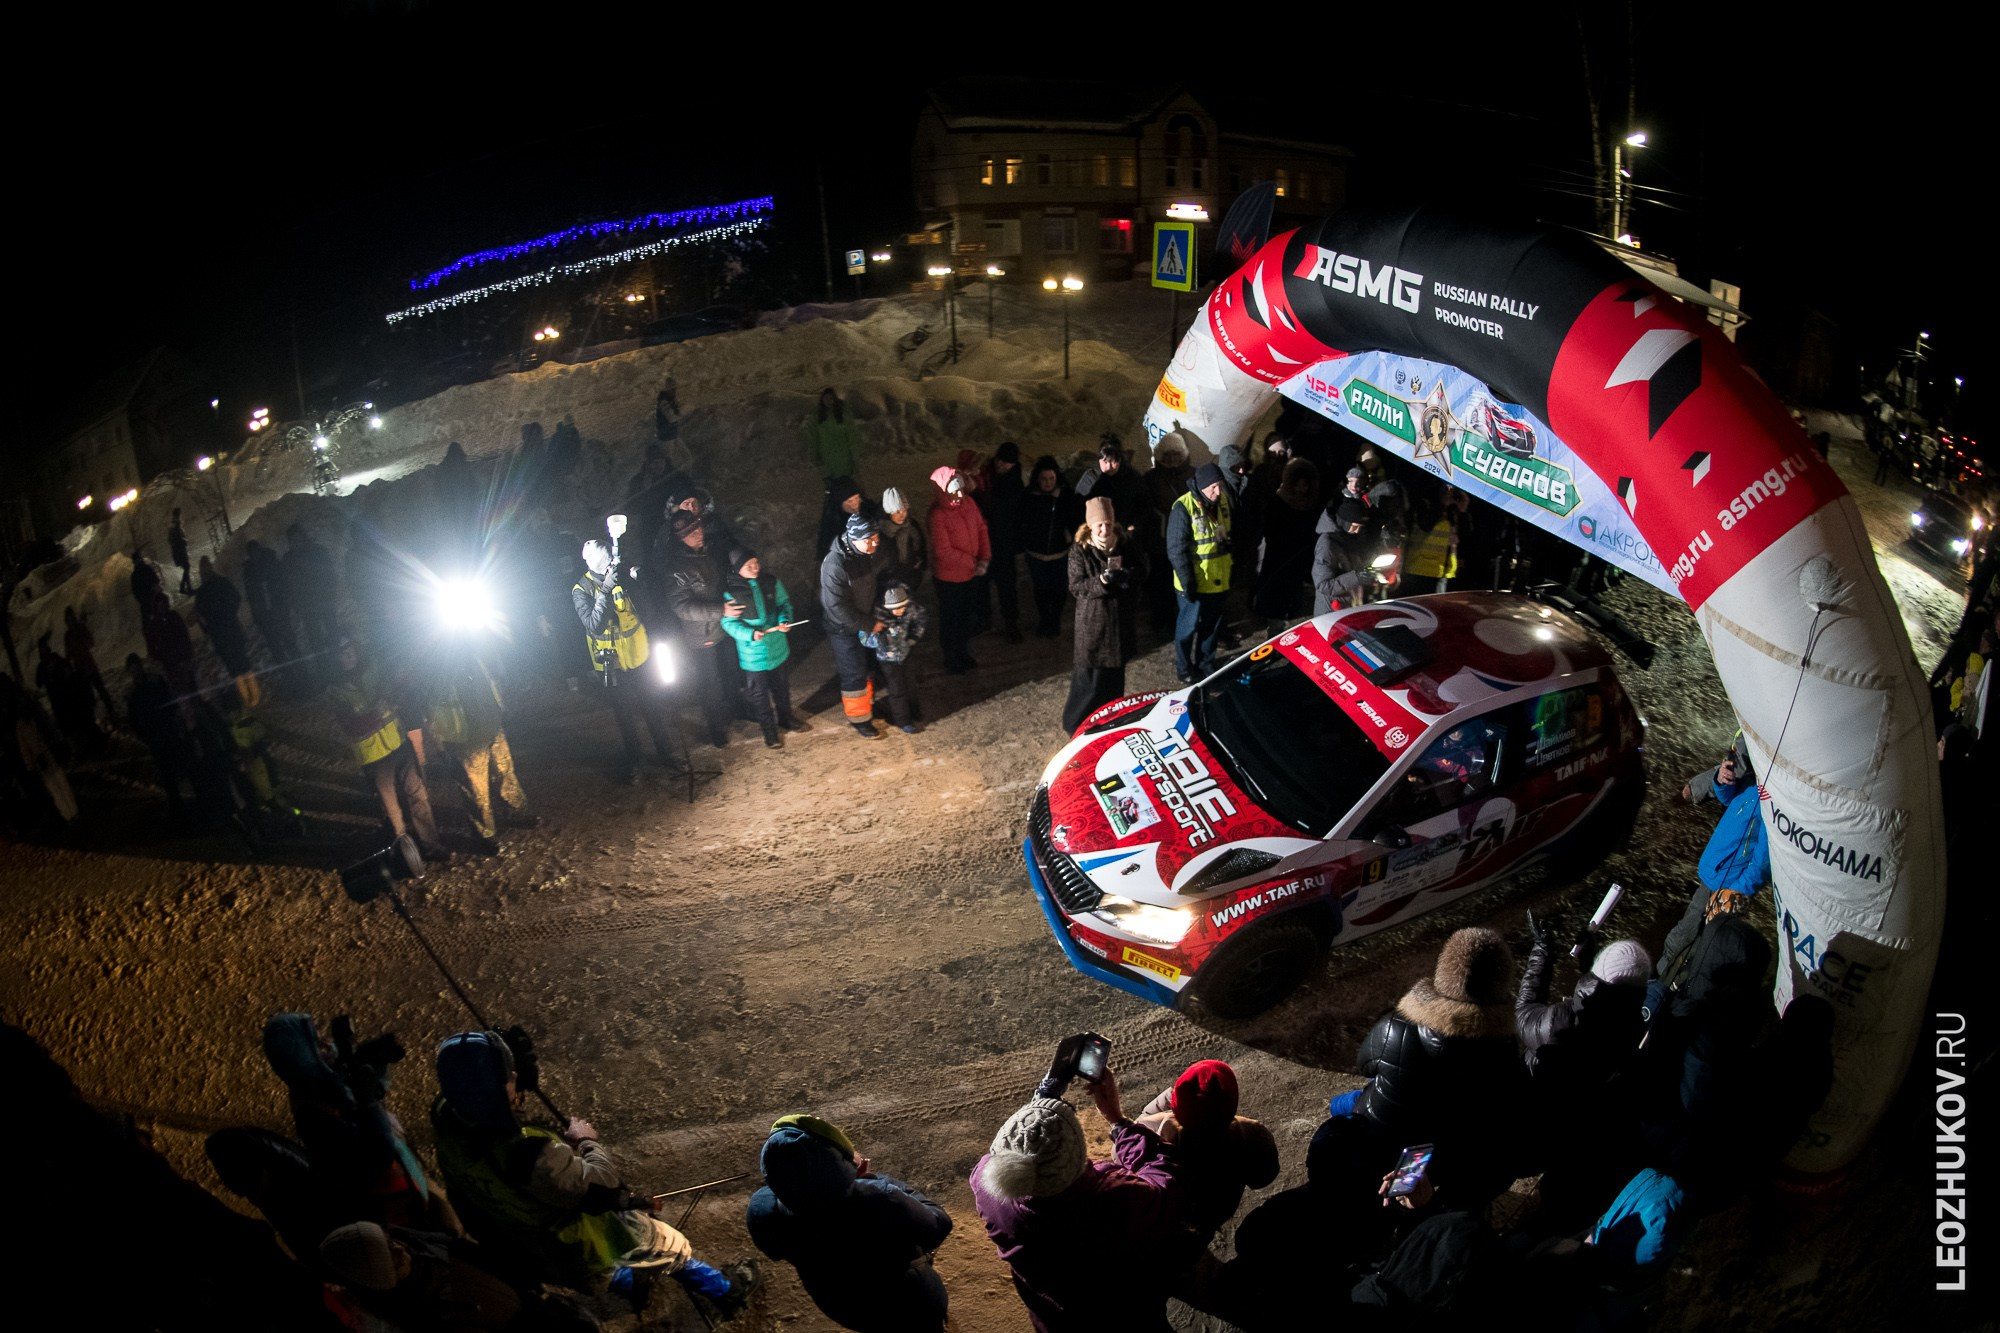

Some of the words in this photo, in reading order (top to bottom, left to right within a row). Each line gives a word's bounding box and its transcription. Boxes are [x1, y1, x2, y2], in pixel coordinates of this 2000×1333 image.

[1304, 245, 1424, 314] ASMG
[1434, 281, 1488, 309] RUSSIAN
[1490, 294, 1540, 321] RALLY
[1214, 309, 1252, 366] asmg.ru
[1434, 306, 1504, 340] PROMOTER
[1351, 388, 1404, 430] РАЛЛИ
[1424, 461, 1442, 476] 2024
[1462, 443, 1566, 506] СУВОРОВ
[1716, 454, 1808, 531] asmg.ru
[1250, 644, 1273, 662] 9
[1296, 645, 1321, 664] ASMG
[1358, 699, 1387, 728] ASMG
[1123, 732, 1208, 848] motorsport
[1770, 800, 1882, 883] YOKOHAMA
[1369, 858, 1382, 884] 9
[1211, 874, 1326, 928] WWW.TAIF.RU
[1773, 881, 1872, 994] SPACE
[1129, 950, 1176, 979] PIRELLI
[1801, 963, 1857, 1008] TRAVEL
